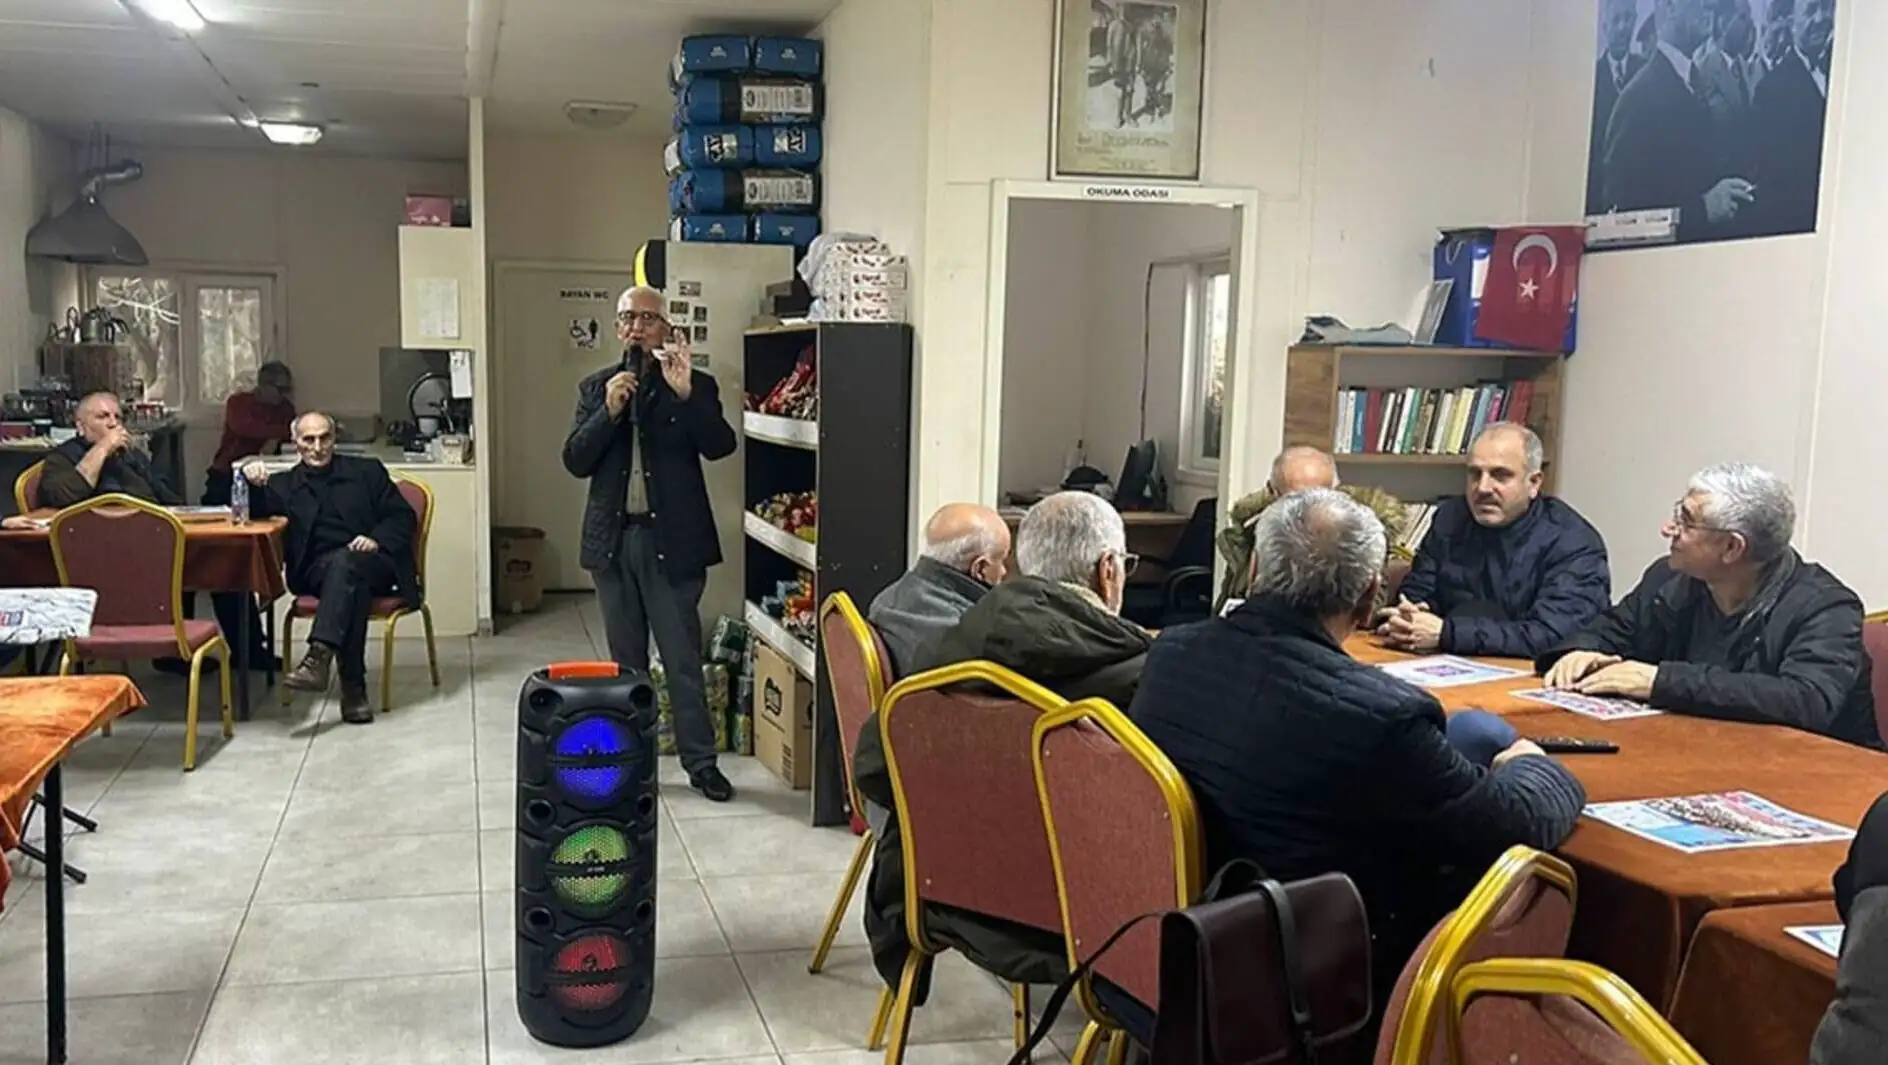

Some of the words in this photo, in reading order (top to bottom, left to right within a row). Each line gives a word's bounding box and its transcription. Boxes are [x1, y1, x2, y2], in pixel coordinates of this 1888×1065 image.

[1087, 187, 1130, 197] OKUMA
[1133, 188, 1169, 198] ODASI
[561, 290, 591, 298] BAYAN
